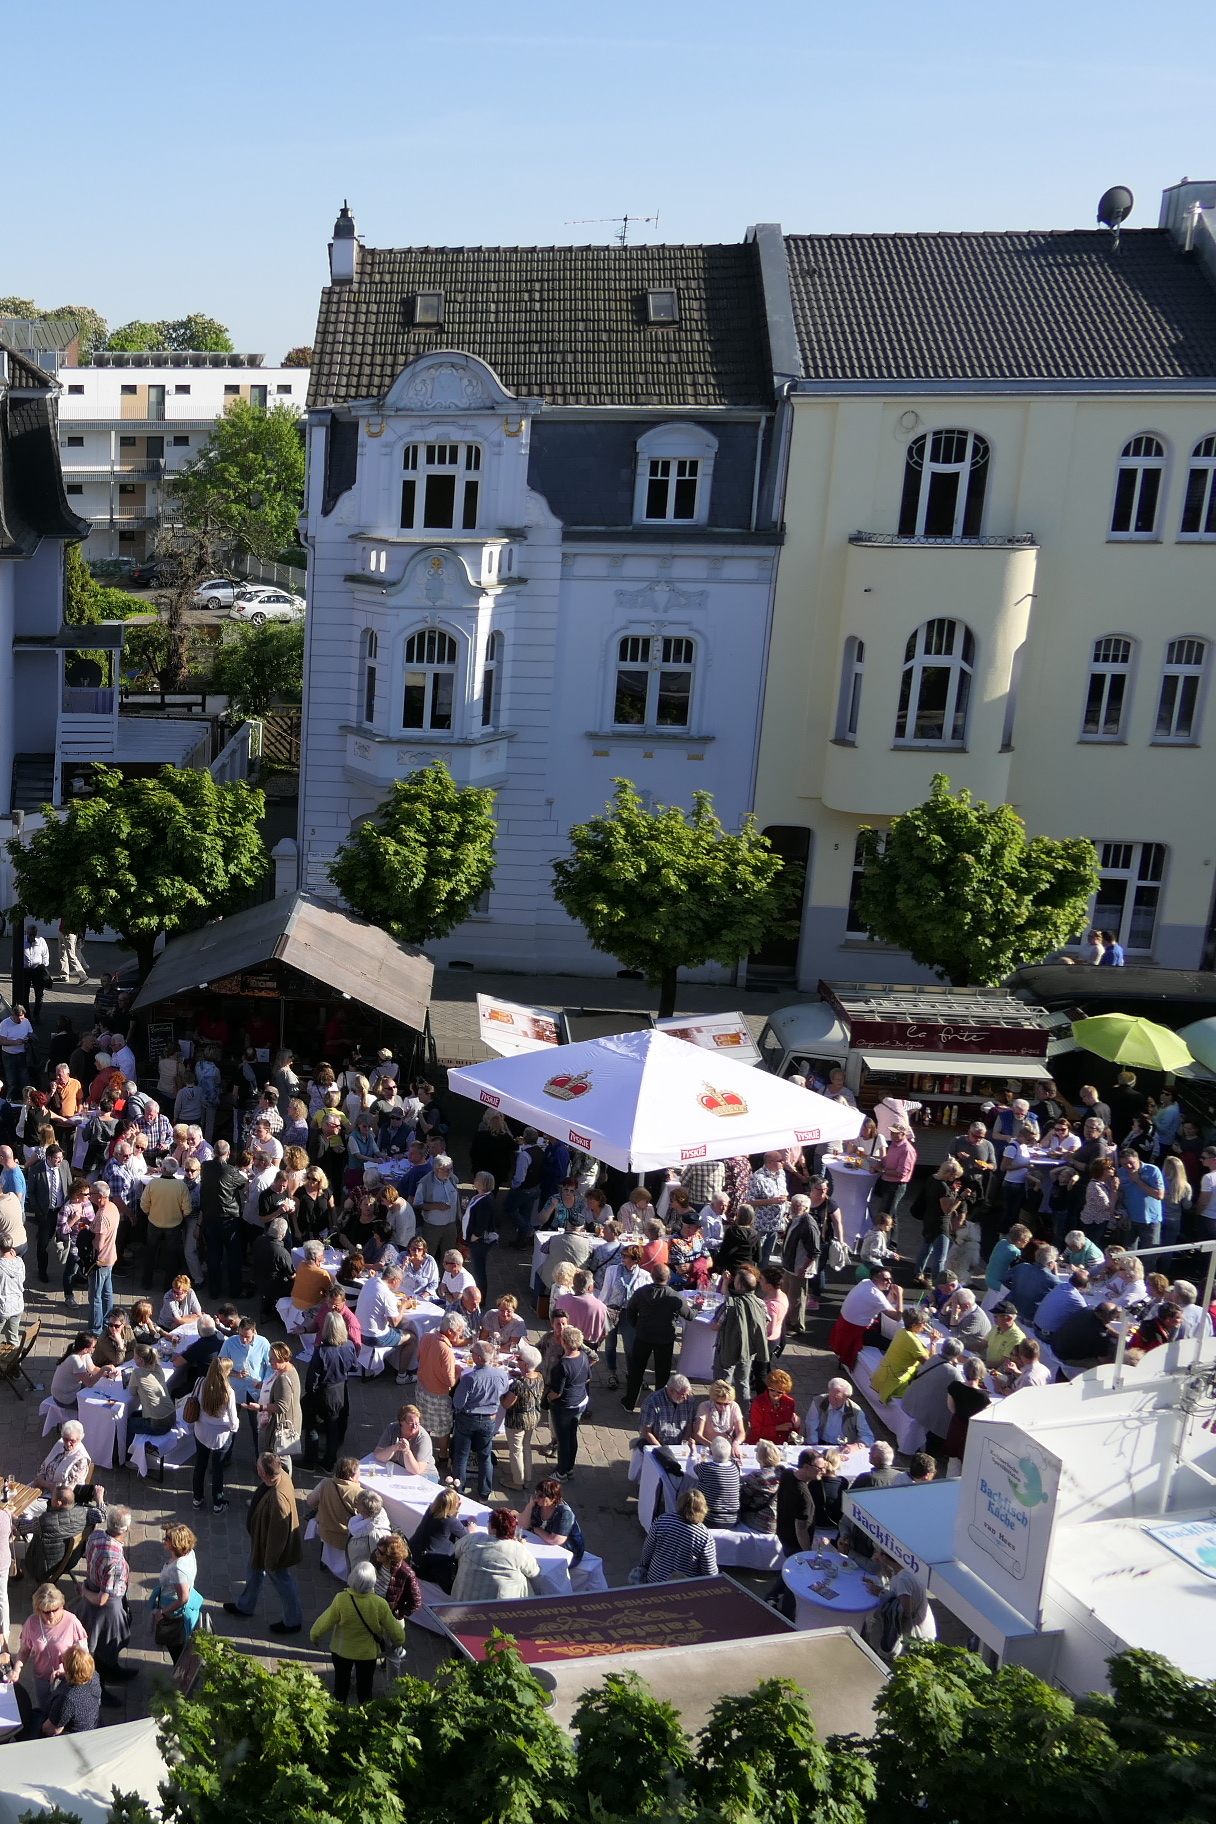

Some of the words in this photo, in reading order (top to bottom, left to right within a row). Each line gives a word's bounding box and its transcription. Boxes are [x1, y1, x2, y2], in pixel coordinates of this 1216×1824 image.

[833, 843, 840, 851] 5
[481, 1091, 500, 1107] TYSKIE
[570, 1131, 591, 1149] TYSKIE
[795, 1129, 820, 1141] TYSKIE
[681, 1146, 706, 1159] TYSKIE
[980, 1478, 1028, 1527] Backfisch
[851, 1502, 920, 1574] Backfisch
[998, 1532, 1016, 1551] Hees
[613, 1586, 733, 1608] ORIENTALISCHES
[488, 1604, 579, 1621] ARABISCHES
[580, 1602, 612, 1613] UND
[531, 1629, 599, 1647] Prinz
[606, 1618, 705, 1641] Falafel
